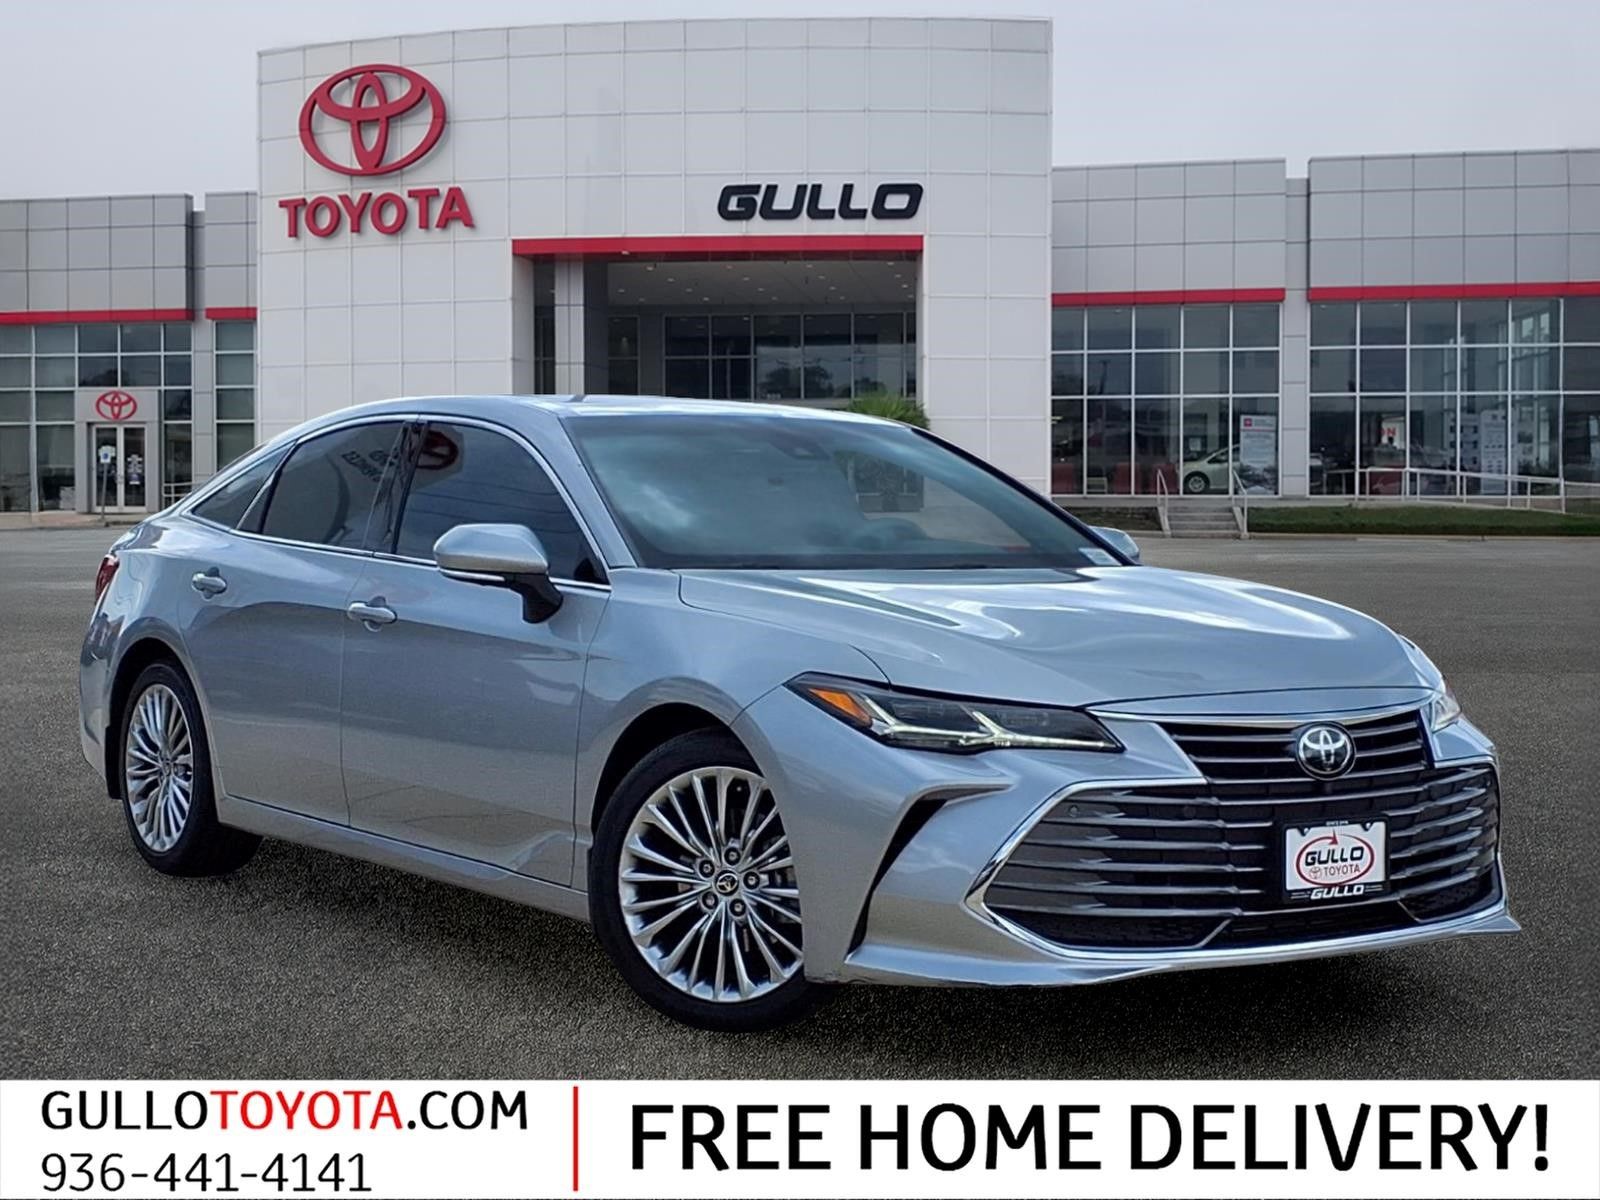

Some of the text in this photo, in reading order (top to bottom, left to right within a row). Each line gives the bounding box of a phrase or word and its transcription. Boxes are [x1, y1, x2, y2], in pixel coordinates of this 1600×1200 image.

[278, 187, 475, 238] TOYOTA
[717, 183, 924, 222] GULLO
[1305, 846, 1364, 867] GULLO
[1323, 863, 1361, 877] TOYOTA
[1310, 884, 1365, 900] GULLO
